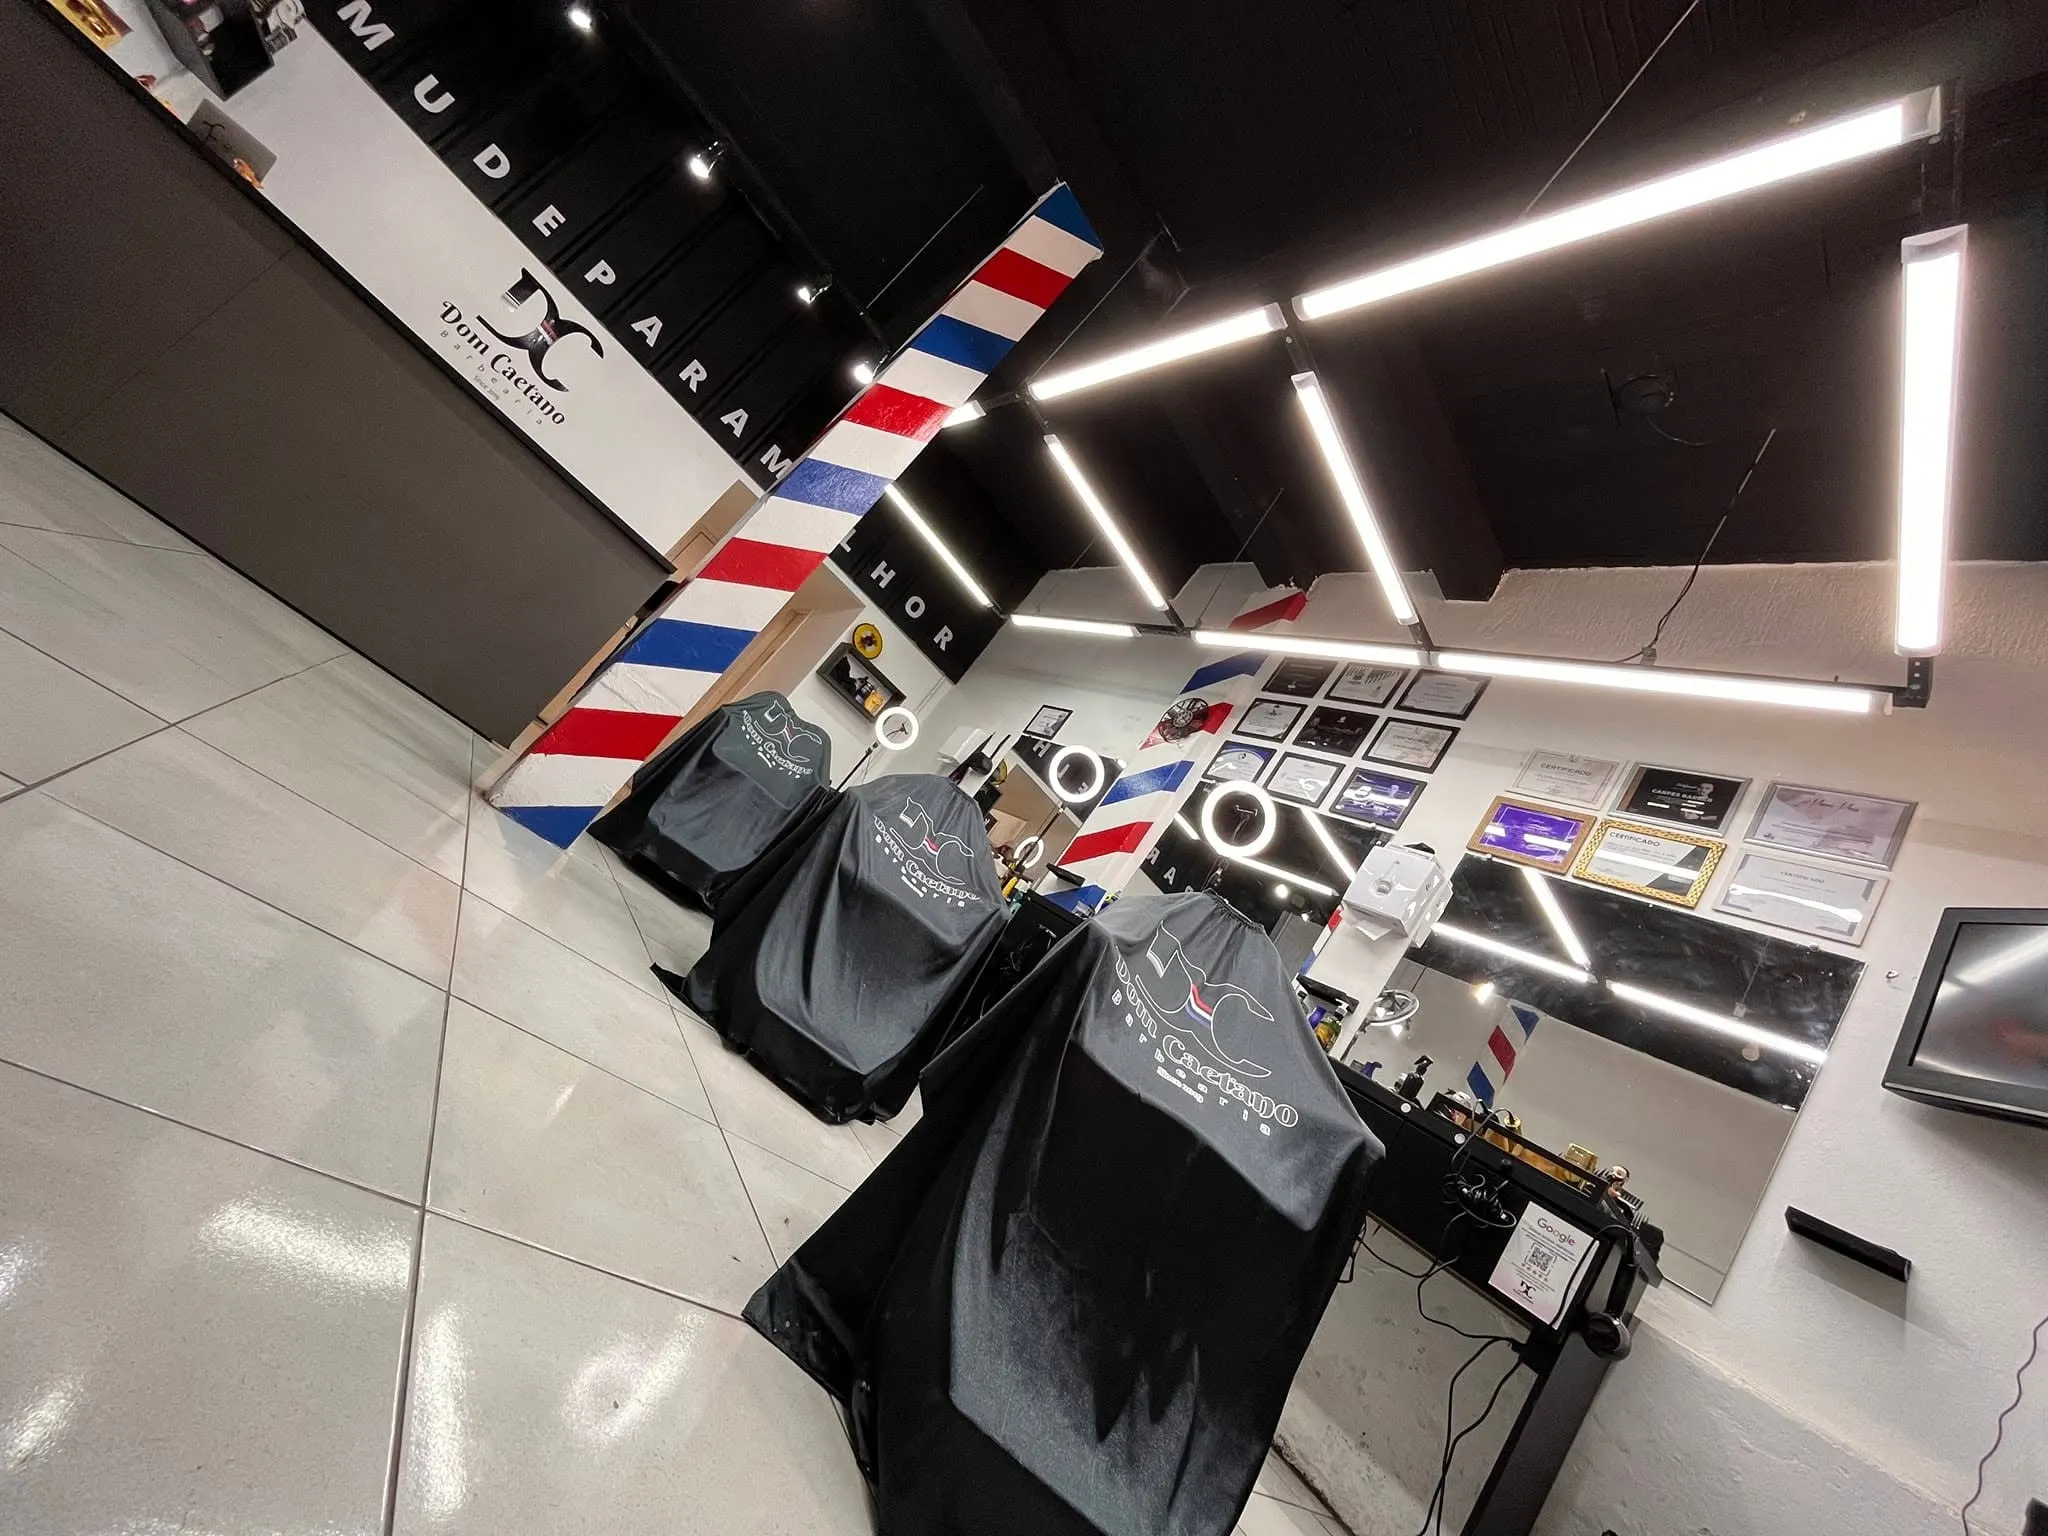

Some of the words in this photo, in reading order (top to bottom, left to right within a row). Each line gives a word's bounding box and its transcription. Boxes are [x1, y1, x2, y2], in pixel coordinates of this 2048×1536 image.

[440, 301, 490, 356] Dom
[490, 353, 566, 425] Caetano
[440, 329, 543, 426] Barbearia
[1609, 831, 1660, 847] CERTIFICADO
[1111, 988, 1271, 1137] Barbearia
[1115, 945, 1158, 1039] Dom
[1162, 1034, 1299, 1128] Caetano
[1537, 1217, 1576, 1246] Google
